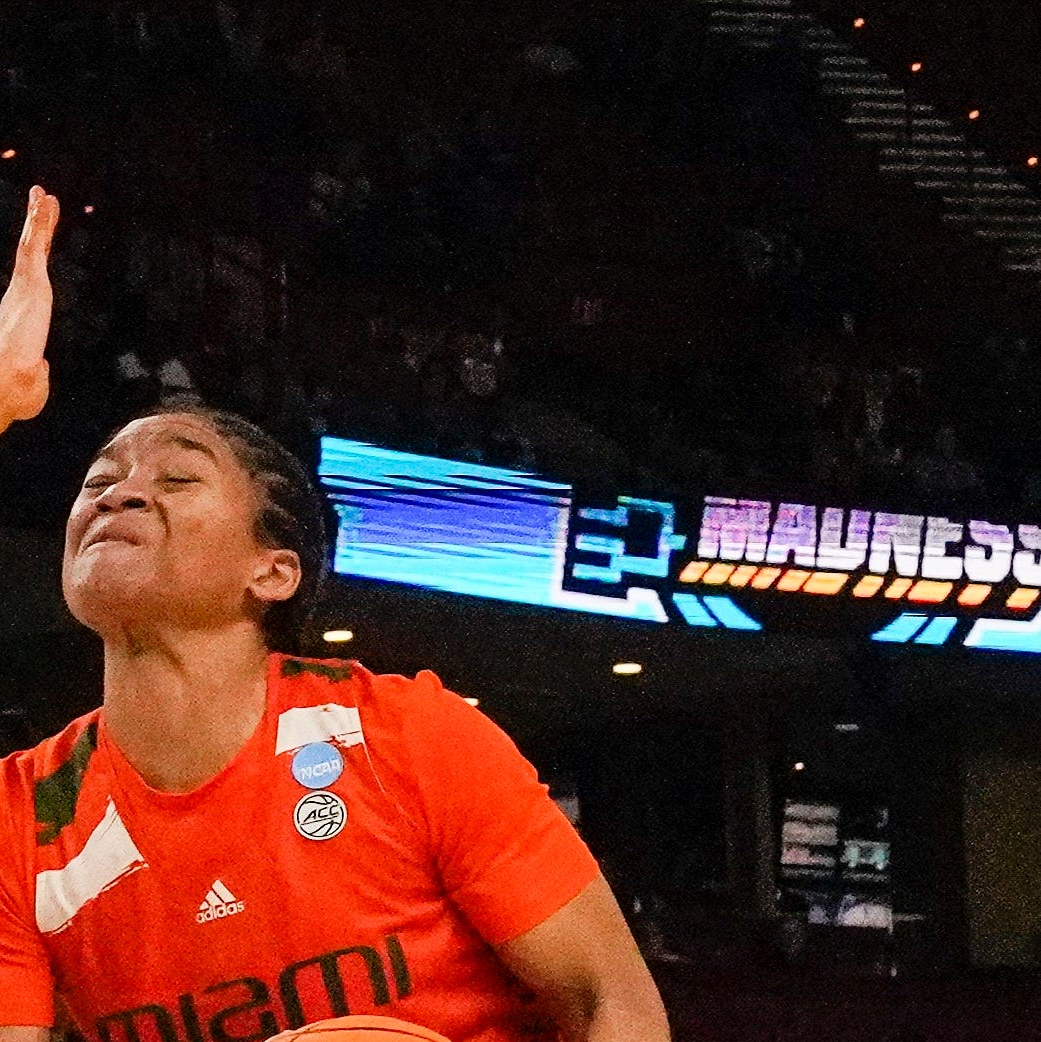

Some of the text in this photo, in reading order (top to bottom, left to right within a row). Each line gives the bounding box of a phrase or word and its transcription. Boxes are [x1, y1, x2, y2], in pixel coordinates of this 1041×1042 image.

[697, 495, 1041, 587] MADNESS
[303, 804, 340, 823] ACC
[195, 899, 245, 924] adidas
